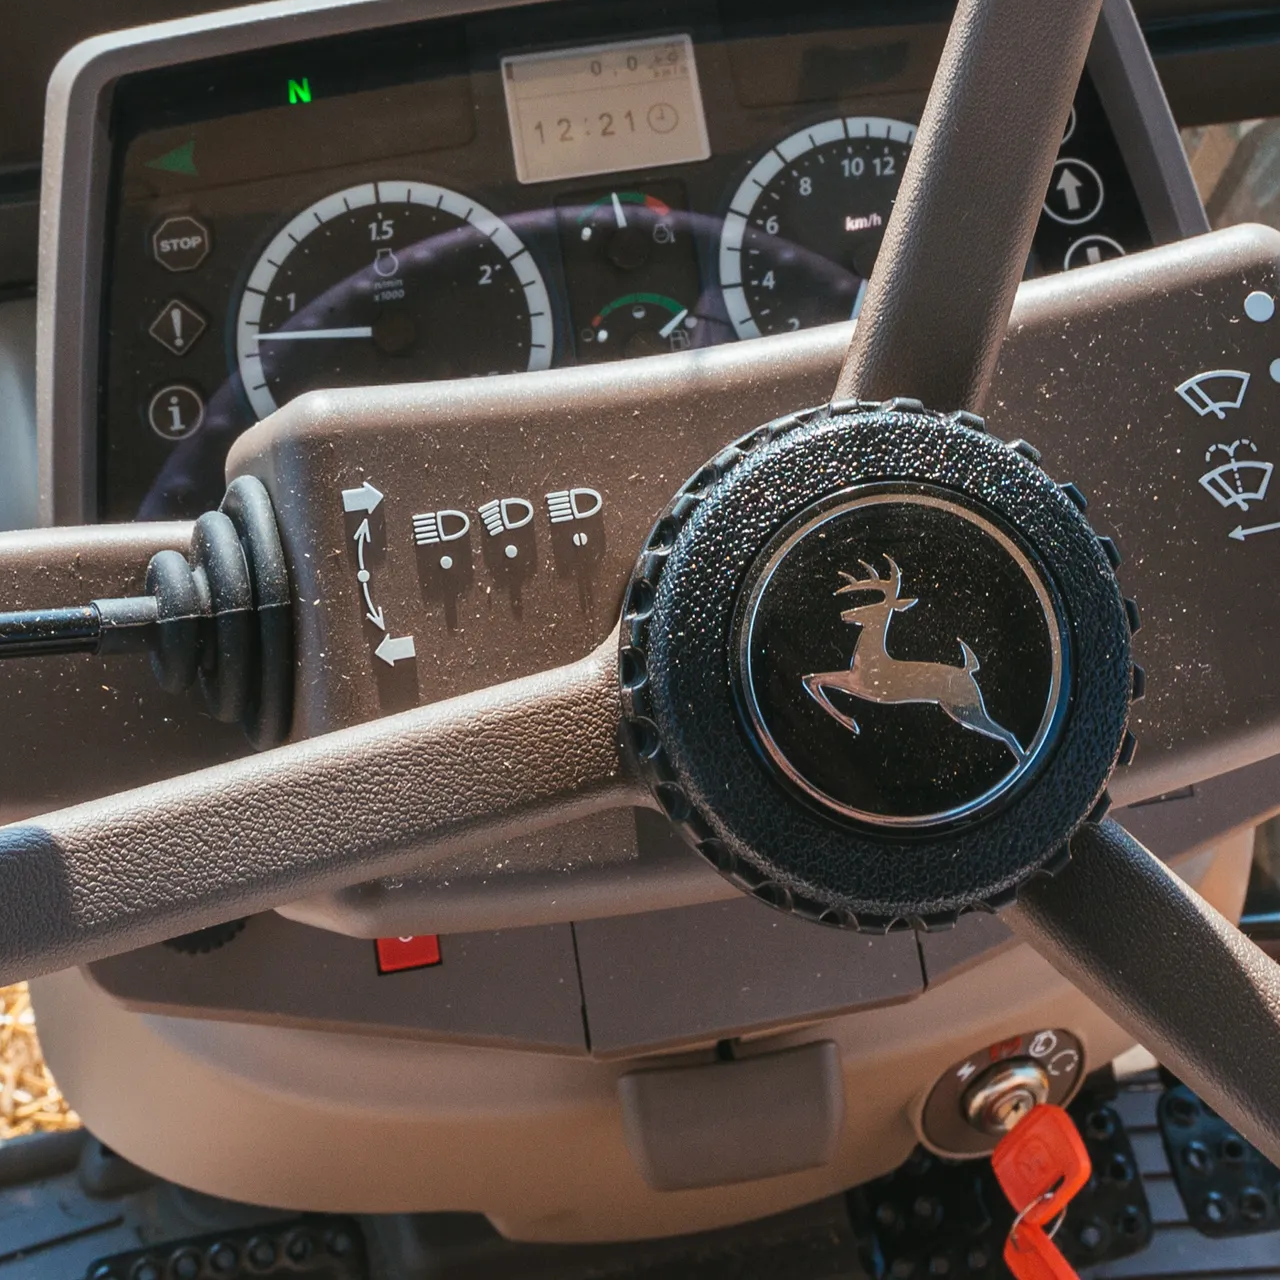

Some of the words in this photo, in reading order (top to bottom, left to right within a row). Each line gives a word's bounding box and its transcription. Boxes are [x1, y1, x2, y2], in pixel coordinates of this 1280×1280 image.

[287, 76, 312, 105] N
[534, 109, 636, 145] 12:21
[840, 157, 865, 178] 10
[872, 156, 896, 177] 12
[799, 176, 813, 197] 8
[765, 215, 780, 235] 6
[844, 213, 882, 231] km/h
[159, 234, 204, 253] STOP
[477, 265, 493, 286] 2
[762, 270, 776, 290] 4
[286, 292, 296, 312] 1
